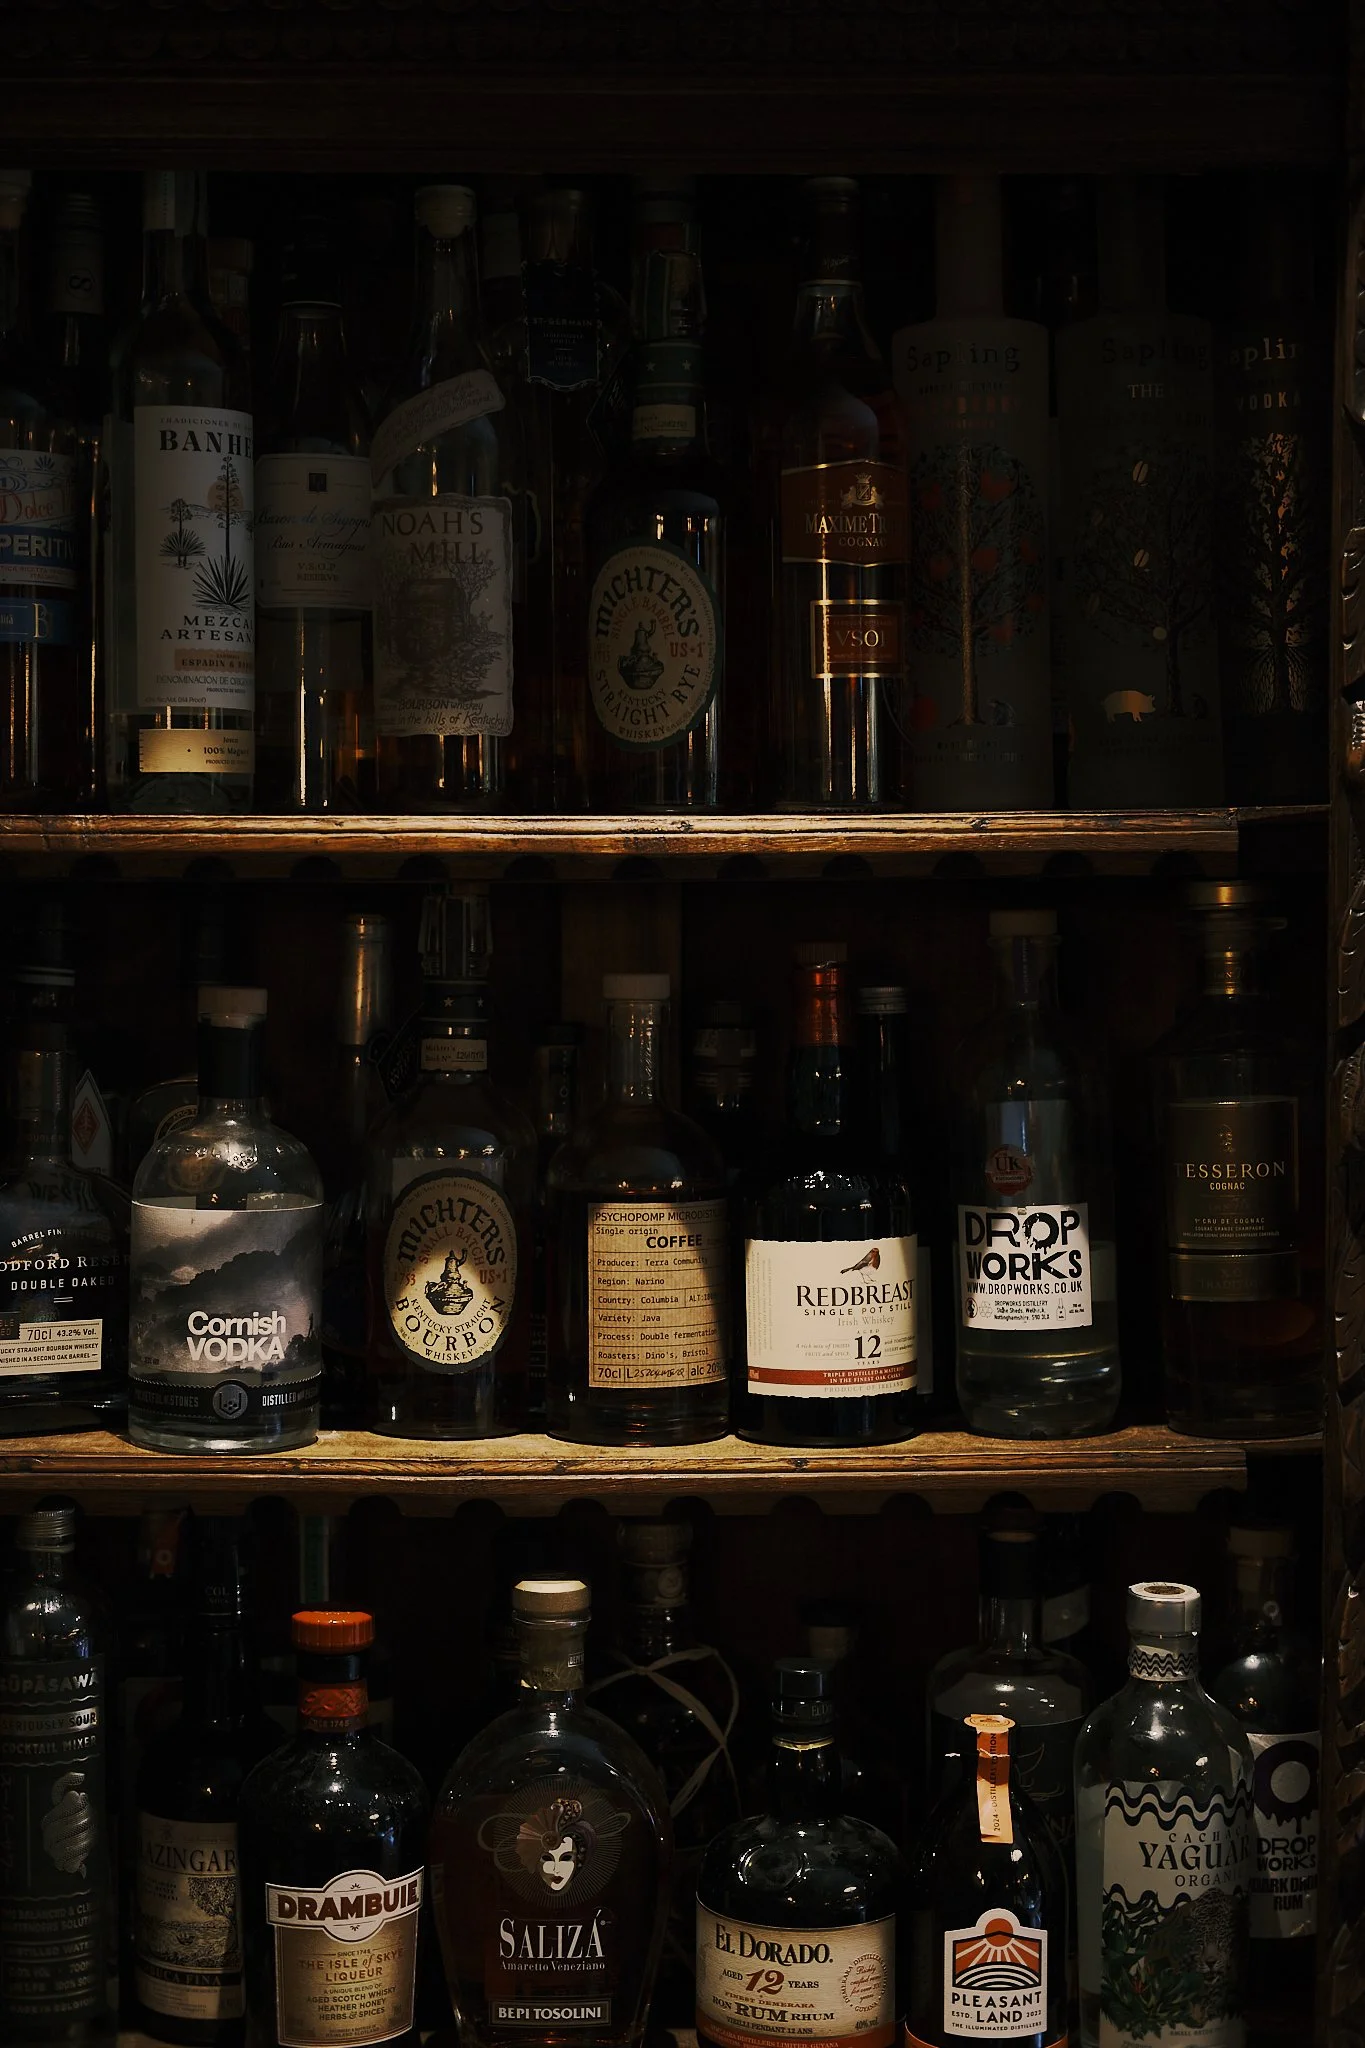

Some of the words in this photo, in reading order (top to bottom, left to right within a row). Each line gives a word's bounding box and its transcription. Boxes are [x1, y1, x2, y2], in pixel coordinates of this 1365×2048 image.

[1173, 1160, 1287, 1180] TESSERON
[1209, 1181, 1246, 1191] COGNAC
[595, 1212, 665, 1222] PSYCHOPOMP
[595, 1226, 625, 1236] Single
[964, 1209, 1081, 1255] DROP
[646, 1234, 703, 1249] COFFEE
[596, 1257, 640, 1267] Producer:
[645, 1258, 669, 1266] Terra
[966, 1249, 1083, 1281] WORKS
[11, 1279, 65, 1291] DOUBLE
[796, 1278, 915, 1307] REDBREAST
[597, 1296, 636, 1306] Country:
[803, 1307, 854, 1316] SINGLE
[861, 1306, 884, 1315] POT
[888, 1301, 912, 1312] STILL
[186, 1310, 287, 1336] Cornish
[598, 1314, 636, 1324] Variety:
[641, 1314, 661, 1323] Java
[597, 1332, 635, 1342] Process:
[640, 1331, 669, 1341] Double
[186, 1336, 285, 1362] VODKA
[853, 1334, 882, 1360] 12
[597, 1367, 622, 1379] 70cl
[68, 1712, 97, 1728] SOUR
[1257, 1834, 1317, 1856] DROP
[1257, 1854, 1317, 1872] WORKS
[277, 1879, 417, 1921] DRAMBUIE
[1273, 1894, 1304, 1911] RUM
[499, 1908, 606, 1960] SALIZÁ
[329, 1957, 359, 1970] ISLE
[325, 1966, 383, 1983] LIQUEUR
[722, 1968, 744, 1982] AGED
[745, 1968, 786, 1995] 12
[788, 1980, 820, 1989] YEARS
[332, 1993, 366, 2003] SCOTCH
[951, 1990, 1043, 2009] PLEASANT
[498, 2006, 530, 2020] BEPI
[533, 2006, 602, 2020] TOSOLINI
[734, 2001, 789, 2023] RUM
[791, 2012, 836, 2022] RHUM
[976, 2009, 1023, 2024] LAND
